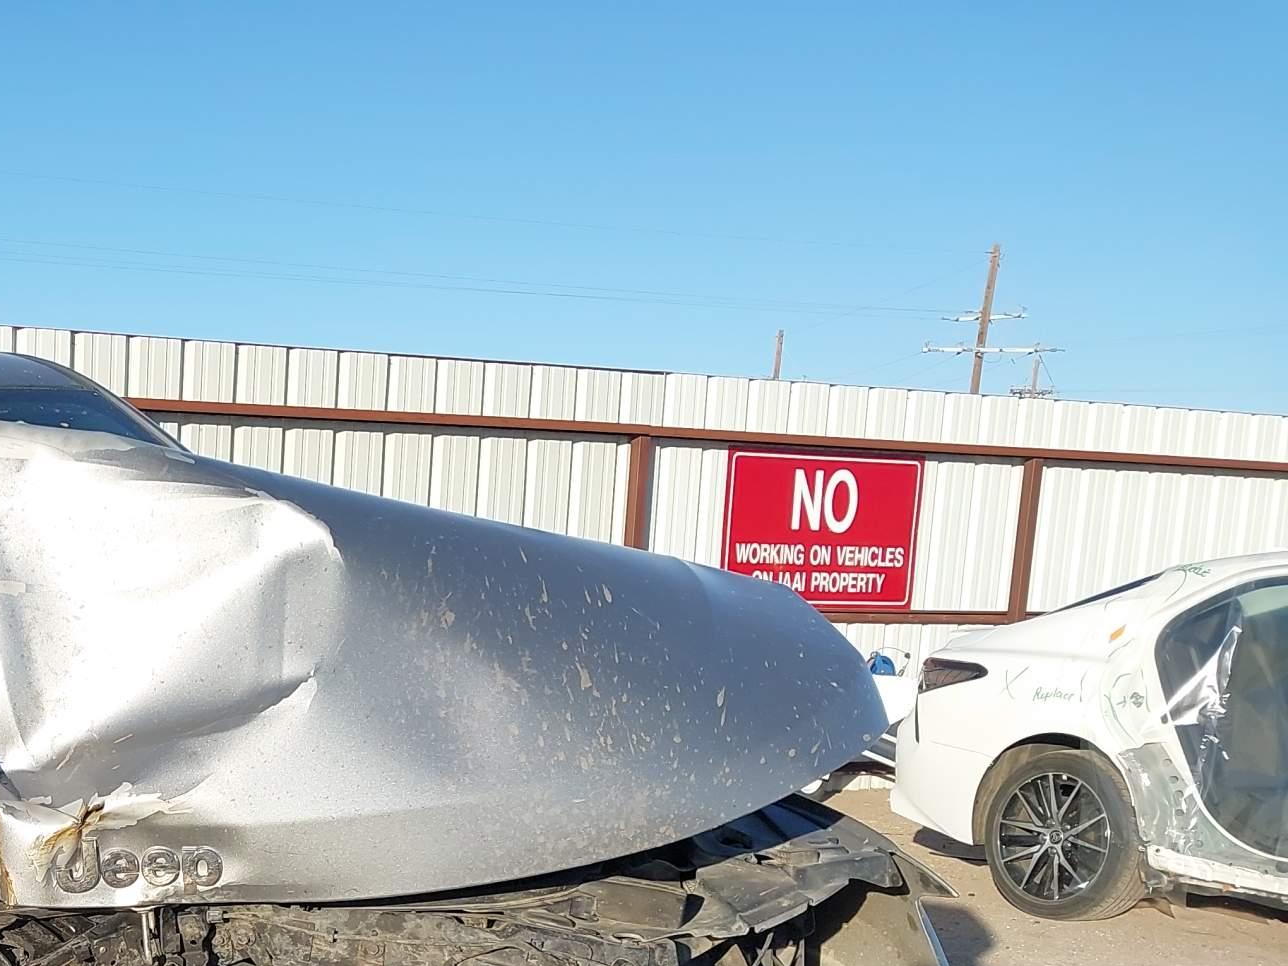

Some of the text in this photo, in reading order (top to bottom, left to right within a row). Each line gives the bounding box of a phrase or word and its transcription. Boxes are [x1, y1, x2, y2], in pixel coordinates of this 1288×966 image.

[790, 468, 859, 534] NO
[735, 542, 905, 568] WORKING ON VEHICLES
[778, 571, 807, 592] IAAI
[810, 572, 886, 593] PROPERTY
[55, 836, 224, 895] Jeep
